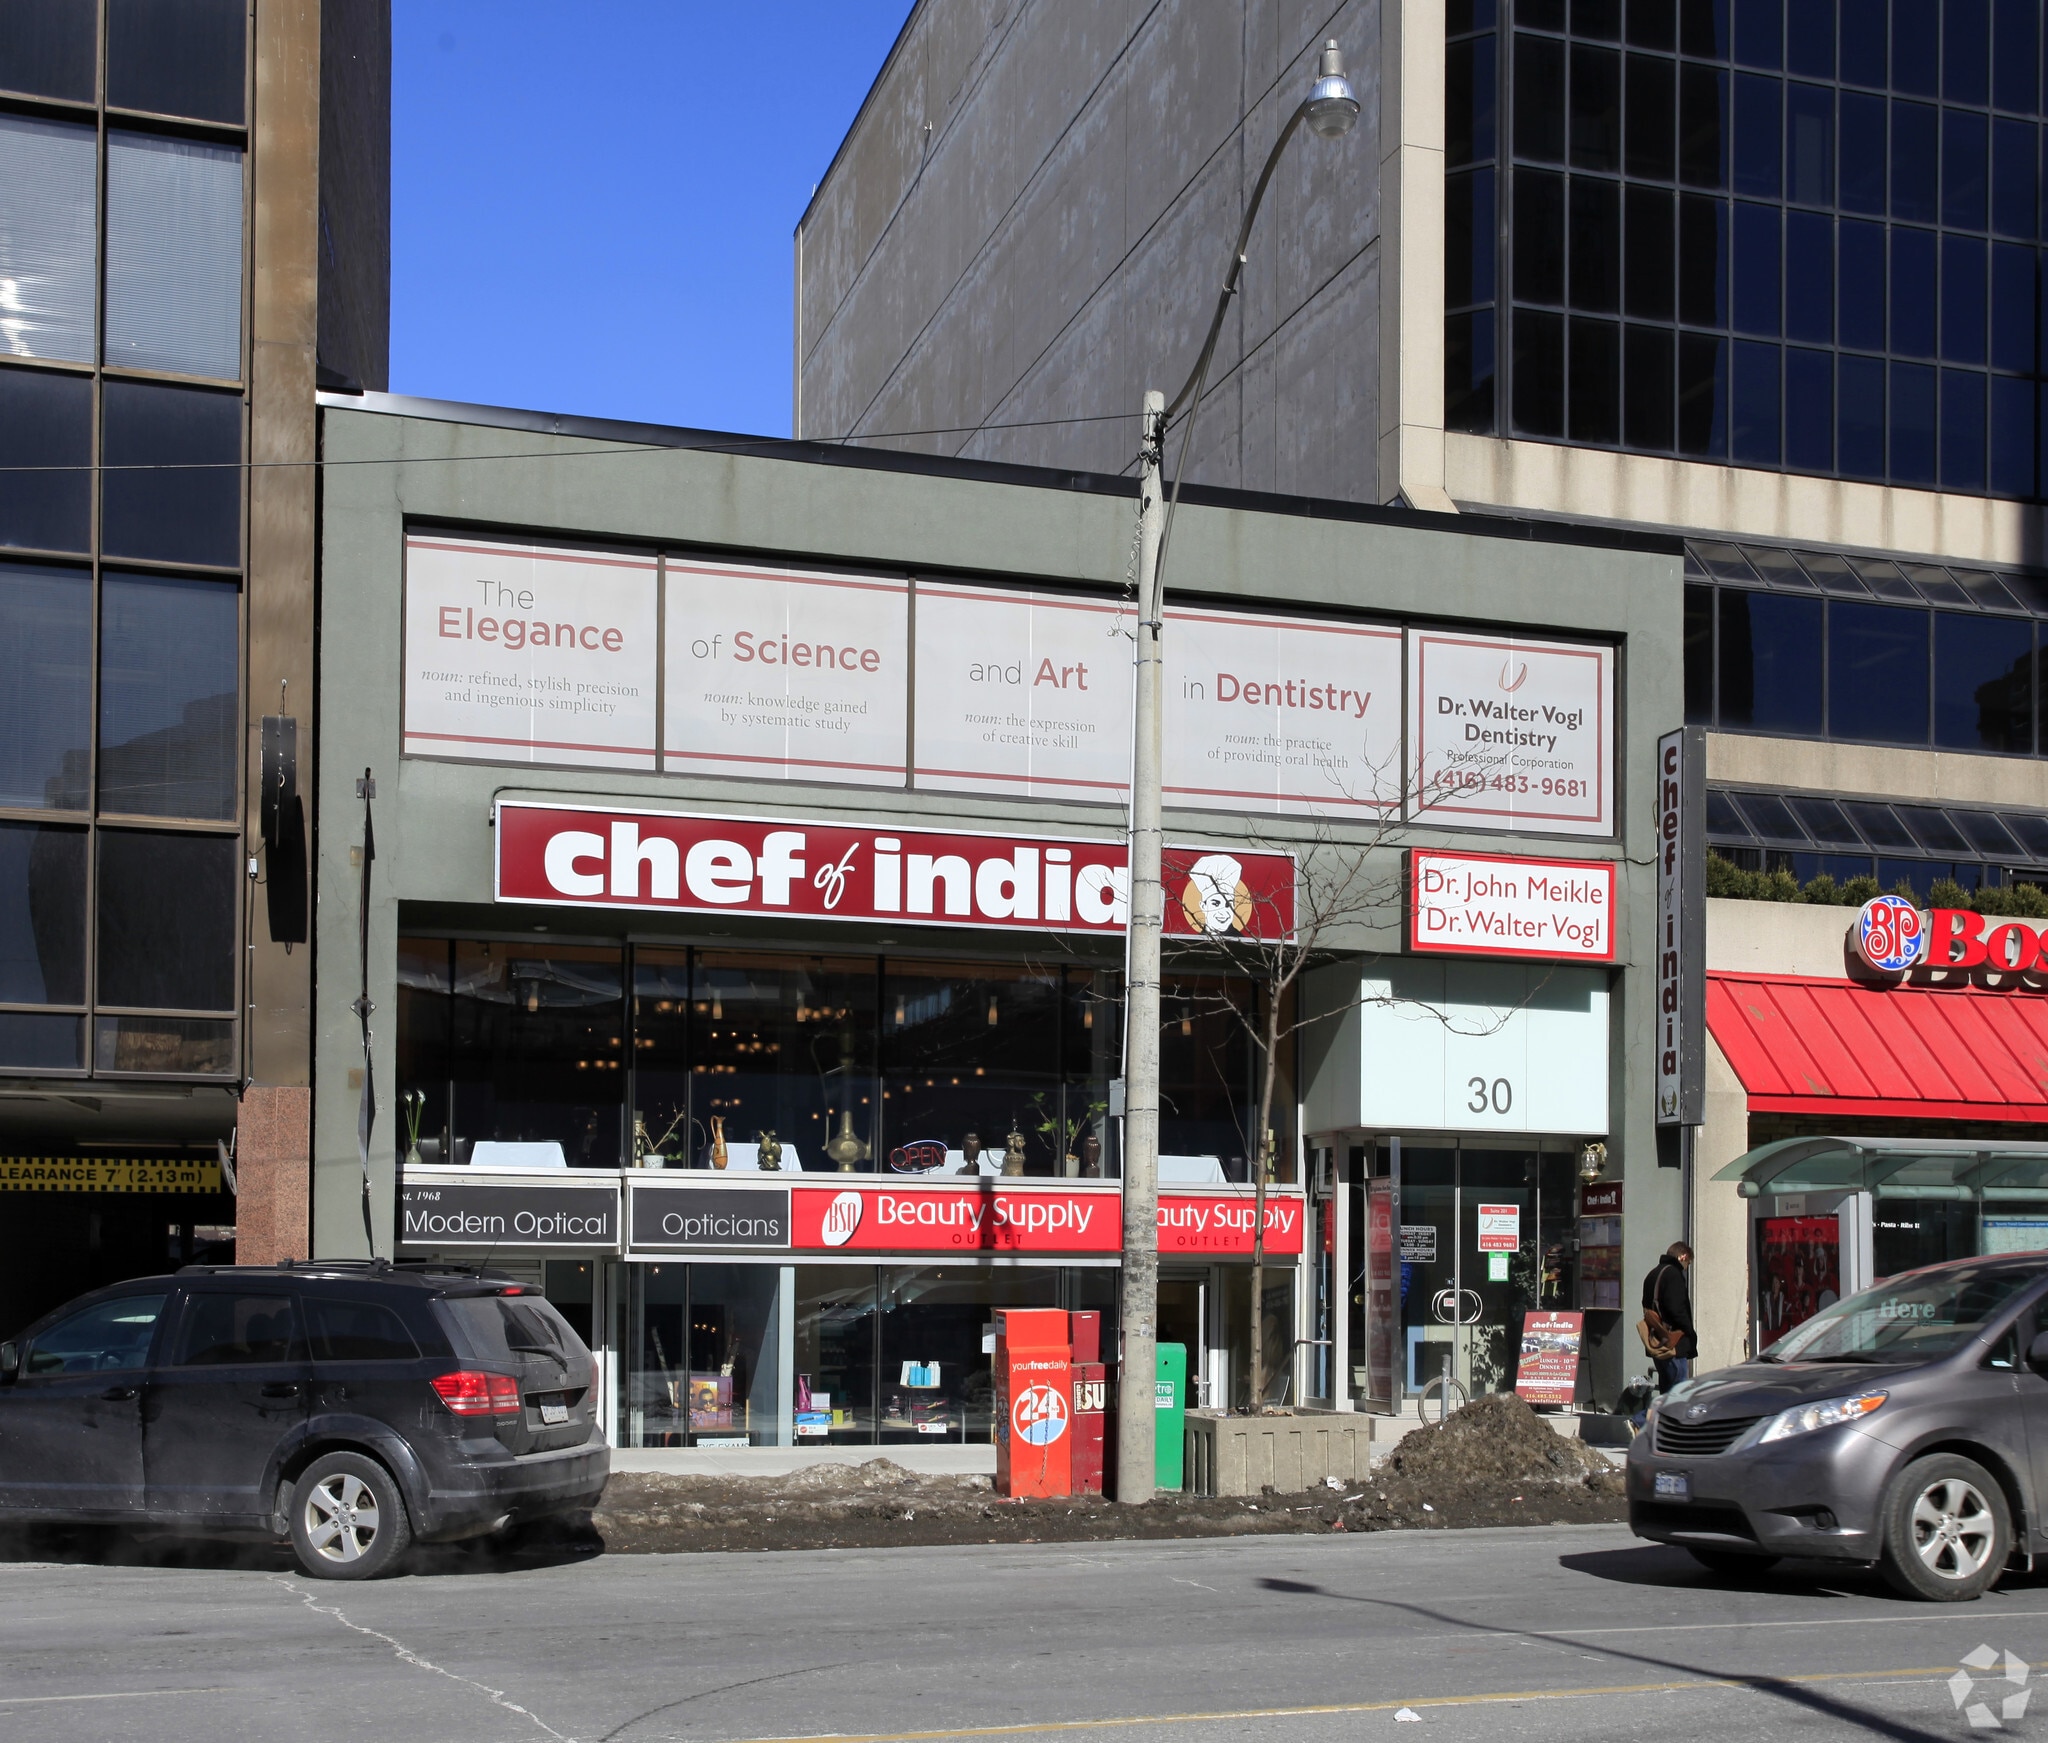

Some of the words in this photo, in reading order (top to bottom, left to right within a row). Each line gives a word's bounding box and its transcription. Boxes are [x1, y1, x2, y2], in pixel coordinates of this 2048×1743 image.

[477, 580, 534, 610] The
[439, 605, 624, 653] Elegance
[691, 634, 723, 660] of
[732, 631, 881, 673] Science
[421, 669, 464, 685] noun:
[468, 672, 523, 692] refined,
[527, 675, 572, 695] stylish
[576, 680, 640, 700] precision
[969, 659, 1021, 685] and
[1033, 657, 1089, 691] Art
[444, 687, 472, 703] and
[476, 690, 545, 709] ingenious
[548, 695, 617, 716] simplicity
[703, 691, 744, 706] noun:
[747, 692, 820, 713] knowledge
[824, 698, 868, 718] gained
[1183, 675, 1204, 701] in
[1216, 672, 1372, 719] Dentistry
[721, 708, 738, 725] by
[741, 710, 810, 730] systematic
[815, 714, 851, 733] study
[964, 713, 1002, 727] noun:
[1006, 714, 1026, 729] the
[1029, 718, 1096, 734] expression
[1438, 696, 1467, 717] Dr.
[1468, 699, 1539, 723] Walter
[1541, 705, 1583, 729] Vogl
[982, 730, 998, 743] of
[999, 732, 1049, 748] creative
[1052, 734, 1079, 749] skill
[1225, 734, 1260, 748] noun:
[1263, 734, 1283, 748] the
[1286, 736, 1332, 754] practice
[1464, 723, 1557, 752] Dentistry
[1207, 747, 1222, 760] of
[1224, 748, 1281, 767] providing
[1285, 752, 1309, 767] oral
[1313, 754, 1349, 770] health
[1447, 750, 1507, 767] Professional
[1511, 756, 1574, 772] Corporation
[1663, 746, 1679, 876] chef
[544, 821, 806, 907] chef
[813, 842, 856, 910] of
[873, 837, 1166, 930] india
[1424, 869, 1459, 895] Dr.
[1464, 873, 1517, 903] John
[1527, 876, 1603, 905] Meikle
[1464, 910, 1548, 938] Walter
[1552, 914, 1600, 948] Vogl
[1662, 914, 1679, 1076] india
[1467, 1076, 1513, 1115] 30
[889, 1147, 947, 1167] OPEN
[417, 1191, 441, 1201] 1968
[405, 1210, 505, 1234] Modern
[513, 1211, 608, 1239] Optical
[662, 1213, 779, 1240] Opticians
[878, 1196, 987, 1229] Beauty
[992, 1197, 1094, 1235] Supply
[952, 1234, 1023, 1246] OUTLET
[1177, 1235, 1240, 1247] OUTLET
[1019, 1390, 1060, 1421] 24
